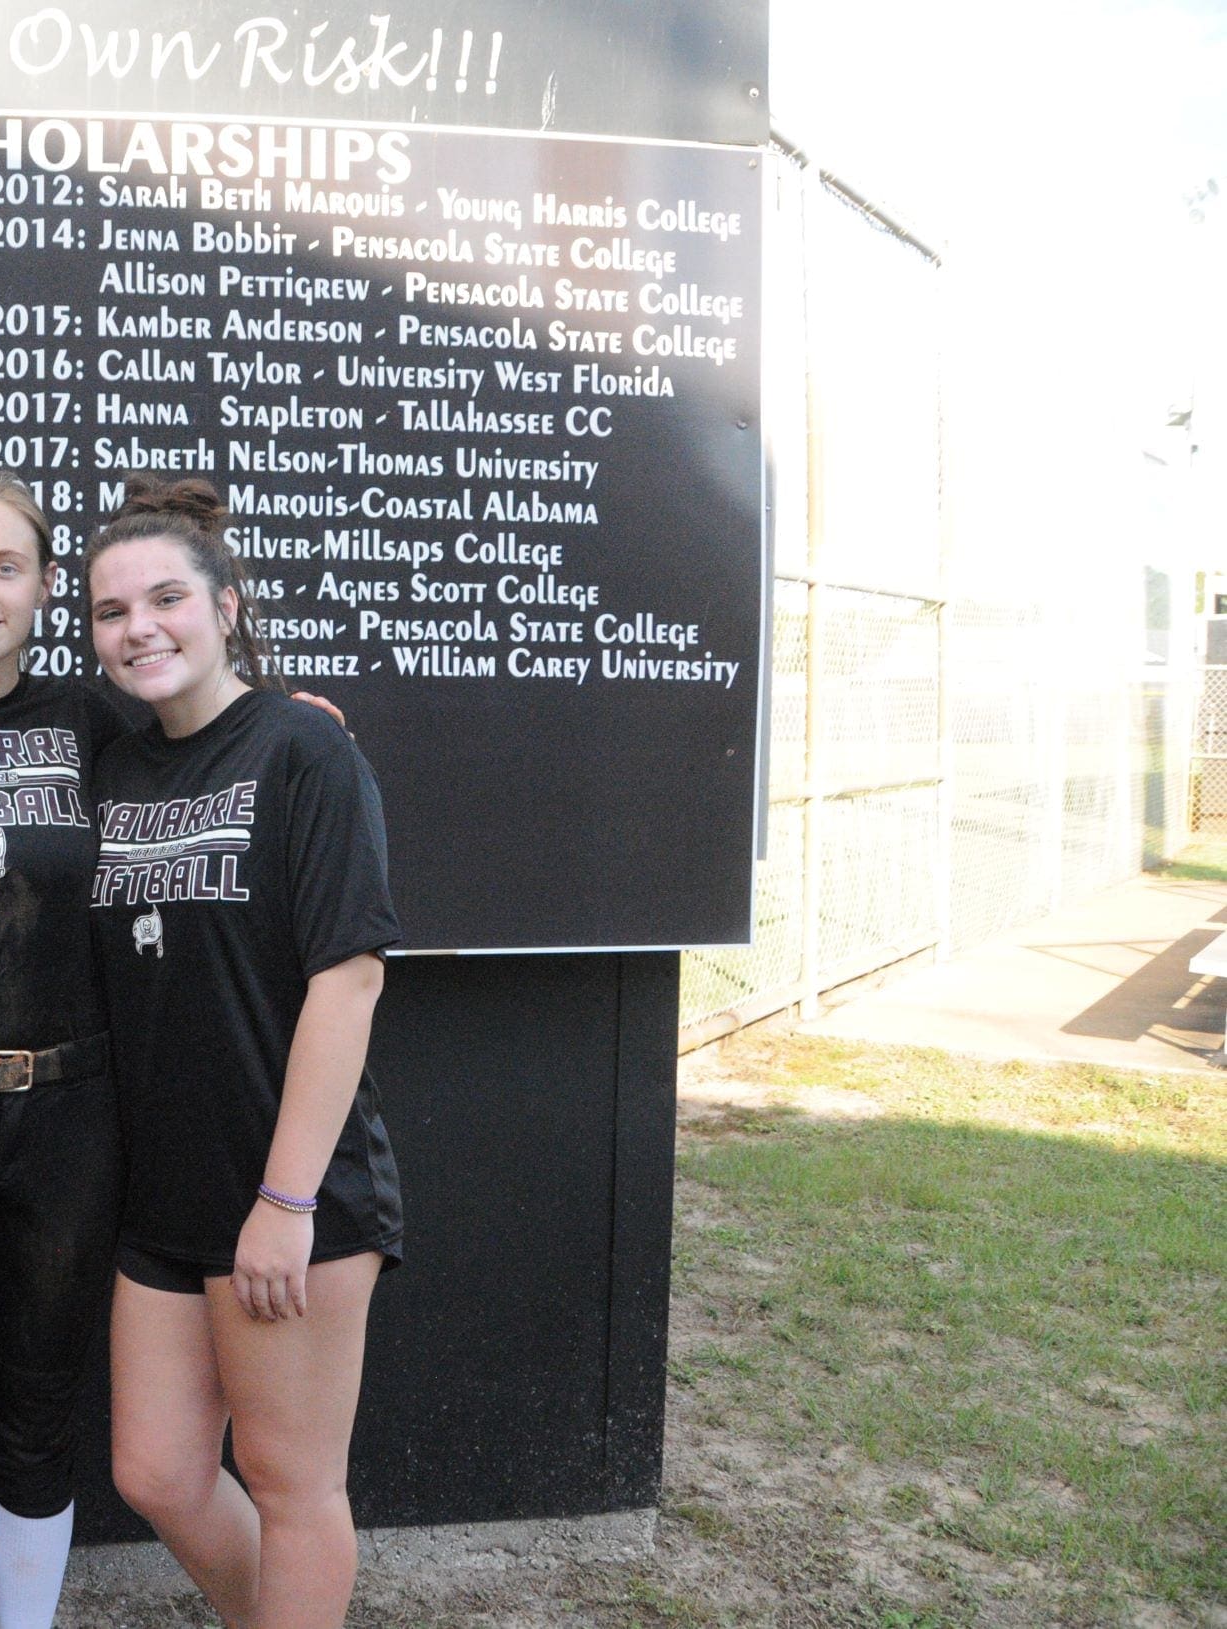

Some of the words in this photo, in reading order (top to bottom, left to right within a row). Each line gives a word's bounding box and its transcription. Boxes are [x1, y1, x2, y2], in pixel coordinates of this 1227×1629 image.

[9, 8, 221, 81] Own
[233, 13, 504, 95] Risk!!!
[99, 174, 187, 209] Sarah
[200, 177, 272, 212] Beth
[284, 180, 405, 219] Marquis
[436, 187, 522, 231] Young
[532, 192, 628, 229] Harris
[636, 198, 742, 242] College
[98, 219, 180, 252] Jenna
[193, 220, 298, 255] Bobbit
[332, 225, 475, 264] Pensacola
[484, 232, 560, 267] State
[570, 237, 676, 280] College
[99, 261, 205, 296] Allison
[219, 265, 370, 306] Pettigrew
[405, 271, 545, 309] Pensacola
[554, 278, 629, 313] State
[638, 282, 743, 325] College
[97, 305, 212, 339] Kamber
[222, 308, 362, 344] Anderson
[399, 314, 538, 350] Pensacola
[548, 319, 623, 354] State
[632, 323, 737, 367] College
[98, 348, 195, 383] Callan
[207, 351, 302, 391] Taylor
[337, 355, 485, 397] University
[494, 361, 562, 393] West
[573, 362, 675, 398] Florida
[97, 393, 189, 426] Hanna
[220, 395, 363, 435] Stapleton
[397, 399, 554, 435] Tallahassee
[565, 405, 613, 438] CC
[94, 436, 215, 471] Sabreth
[229, 439, 444, 477] Nelson-Thomas
[456, 447, 599, 490] University
[31, 480, 84, 513] 18:
[228, 484, 474, 520] Marquis-Coastal
[482, 490, 599, 525] Alabama
[455, 532, 563, 573] College
[316, 571, 400, 608] Agnes
[410, 572, 487, 603] Scott
[497, 574, 599, 612] College
[33, 607, 81, 638] 19:
[359, 609, 498, 642] Pensacola
[509, 611, 583, 643] State
[594, 612, 699, 652] College
[29, 646, 83, 677] 20:
[392, 645, 496, 677] William
[507, 647, 591, 686] Carey
[601, 649, 740, 689] University
[89, 855, 250, 908] OFTBALL
